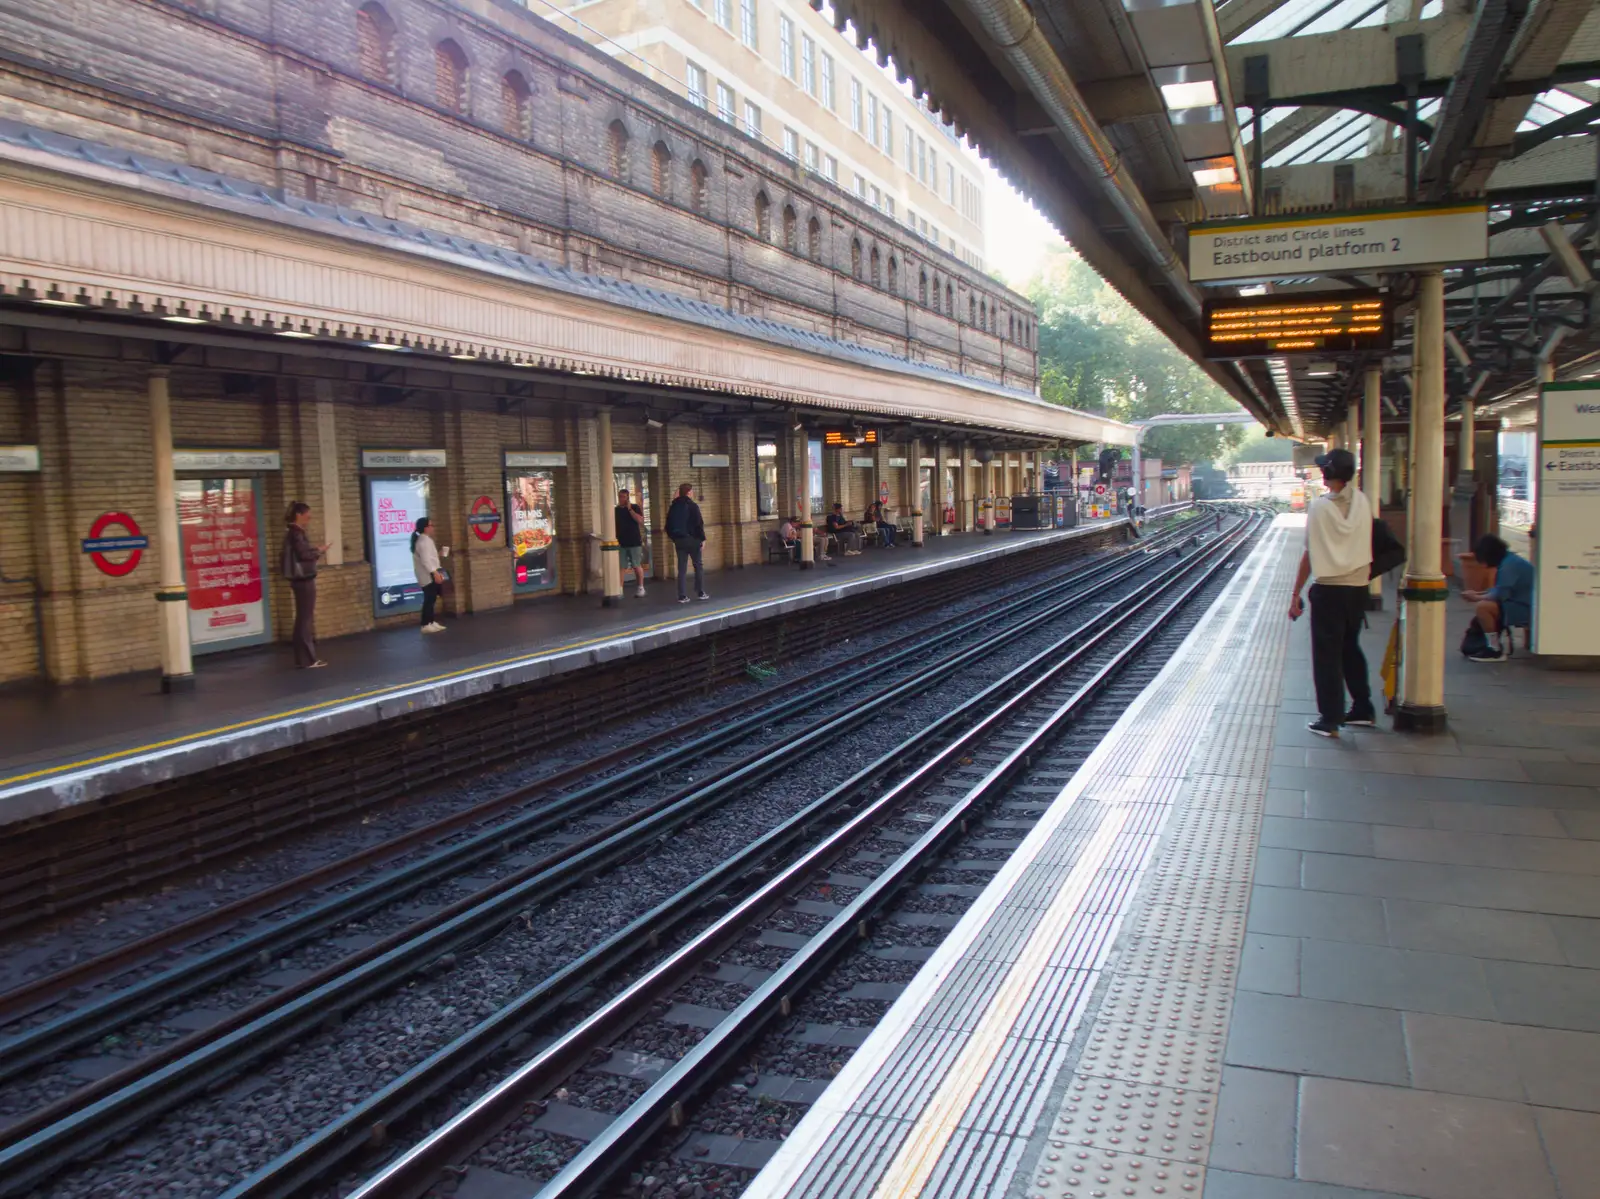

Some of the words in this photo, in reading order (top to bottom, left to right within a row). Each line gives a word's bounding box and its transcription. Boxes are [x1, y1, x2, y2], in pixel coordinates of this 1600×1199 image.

[1213, 235, 1261, 248] District
[1265, 231, 1289, 243] and
[1292, 228, 1330, 242] Circle
[1334, 226, 1366, 239] lines
[1213, 246, 1302, 266] Eastbound
[1308, 239, 1386, 262] platform
[1391, 238, 1401, 252] 2
[378, 498, 393, 509] ASK
[378, 510, 407, 522] BETTER
